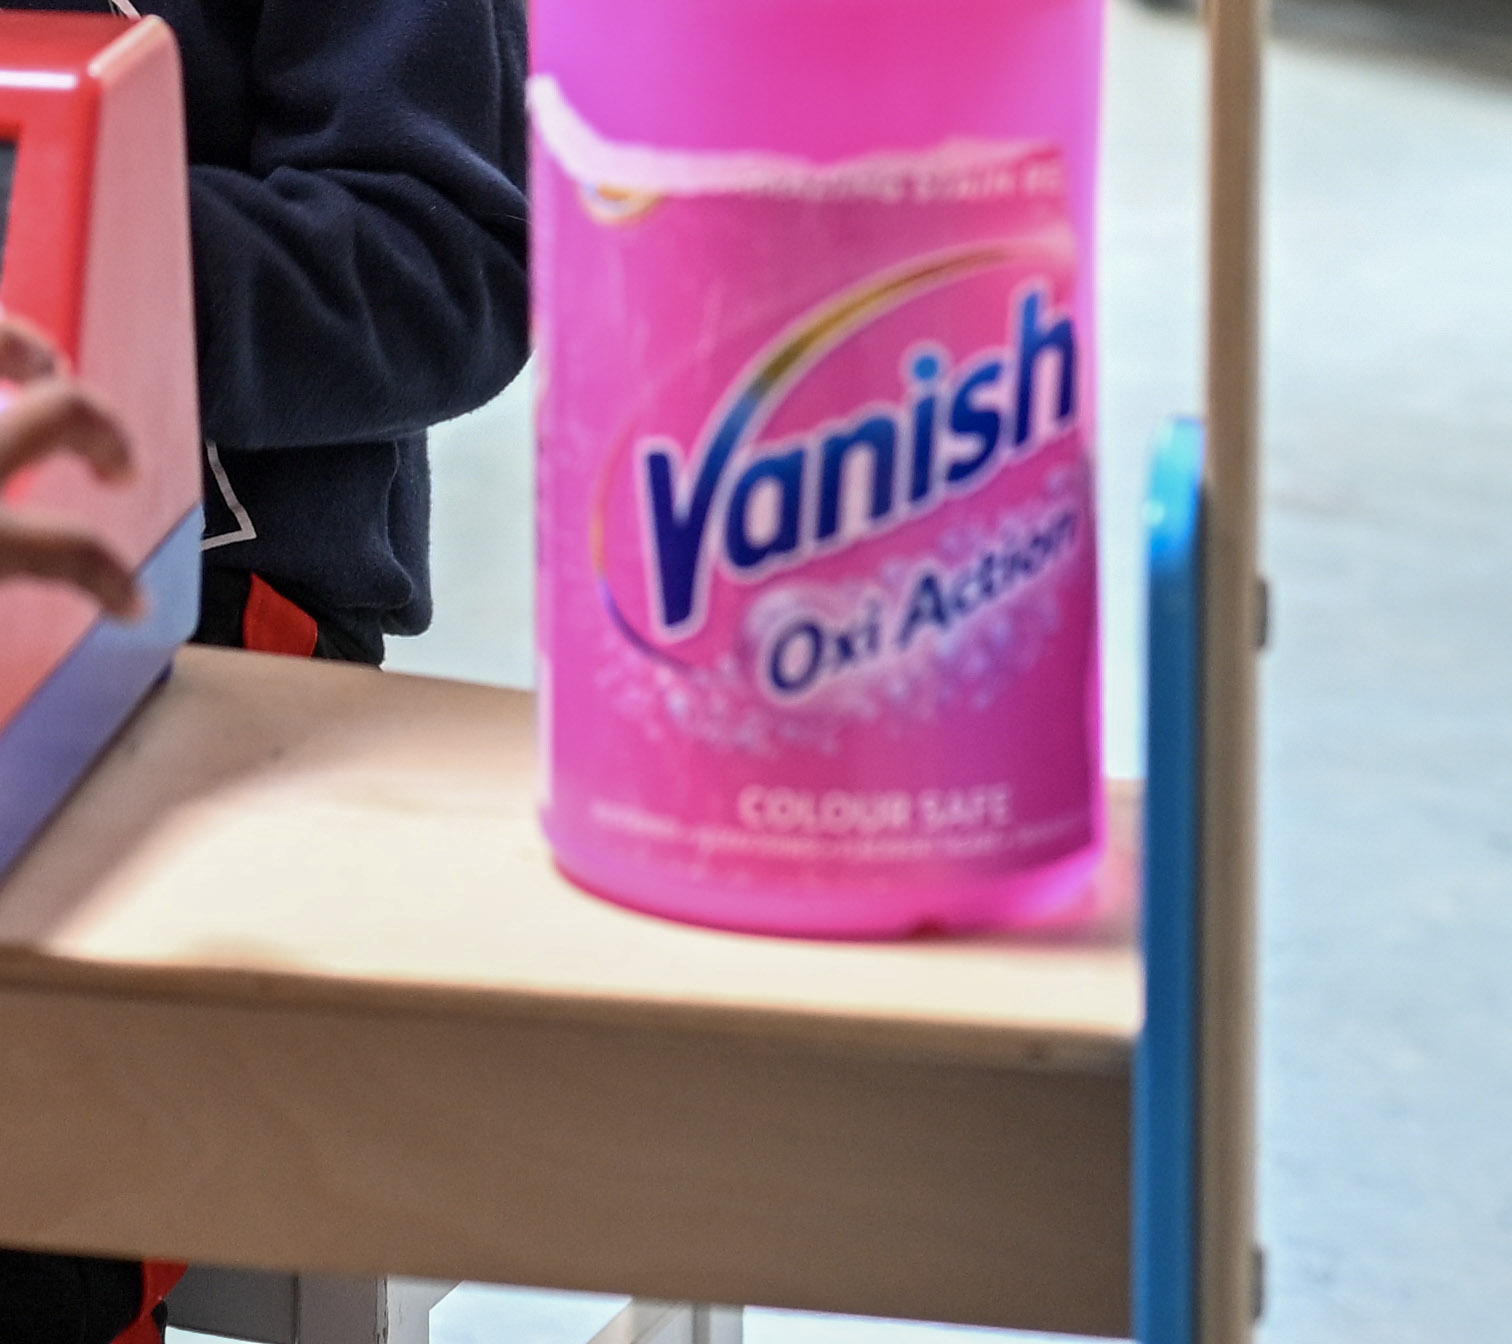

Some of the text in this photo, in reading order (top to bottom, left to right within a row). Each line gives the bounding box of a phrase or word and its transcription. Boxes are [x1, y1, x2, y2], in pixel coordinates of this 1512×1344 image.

[640, 280, 1078, 636] Vanish
[768, 508, 1078, 695] Oxi Action
[737, 782, 1013, 833] COLOUR SAFE
